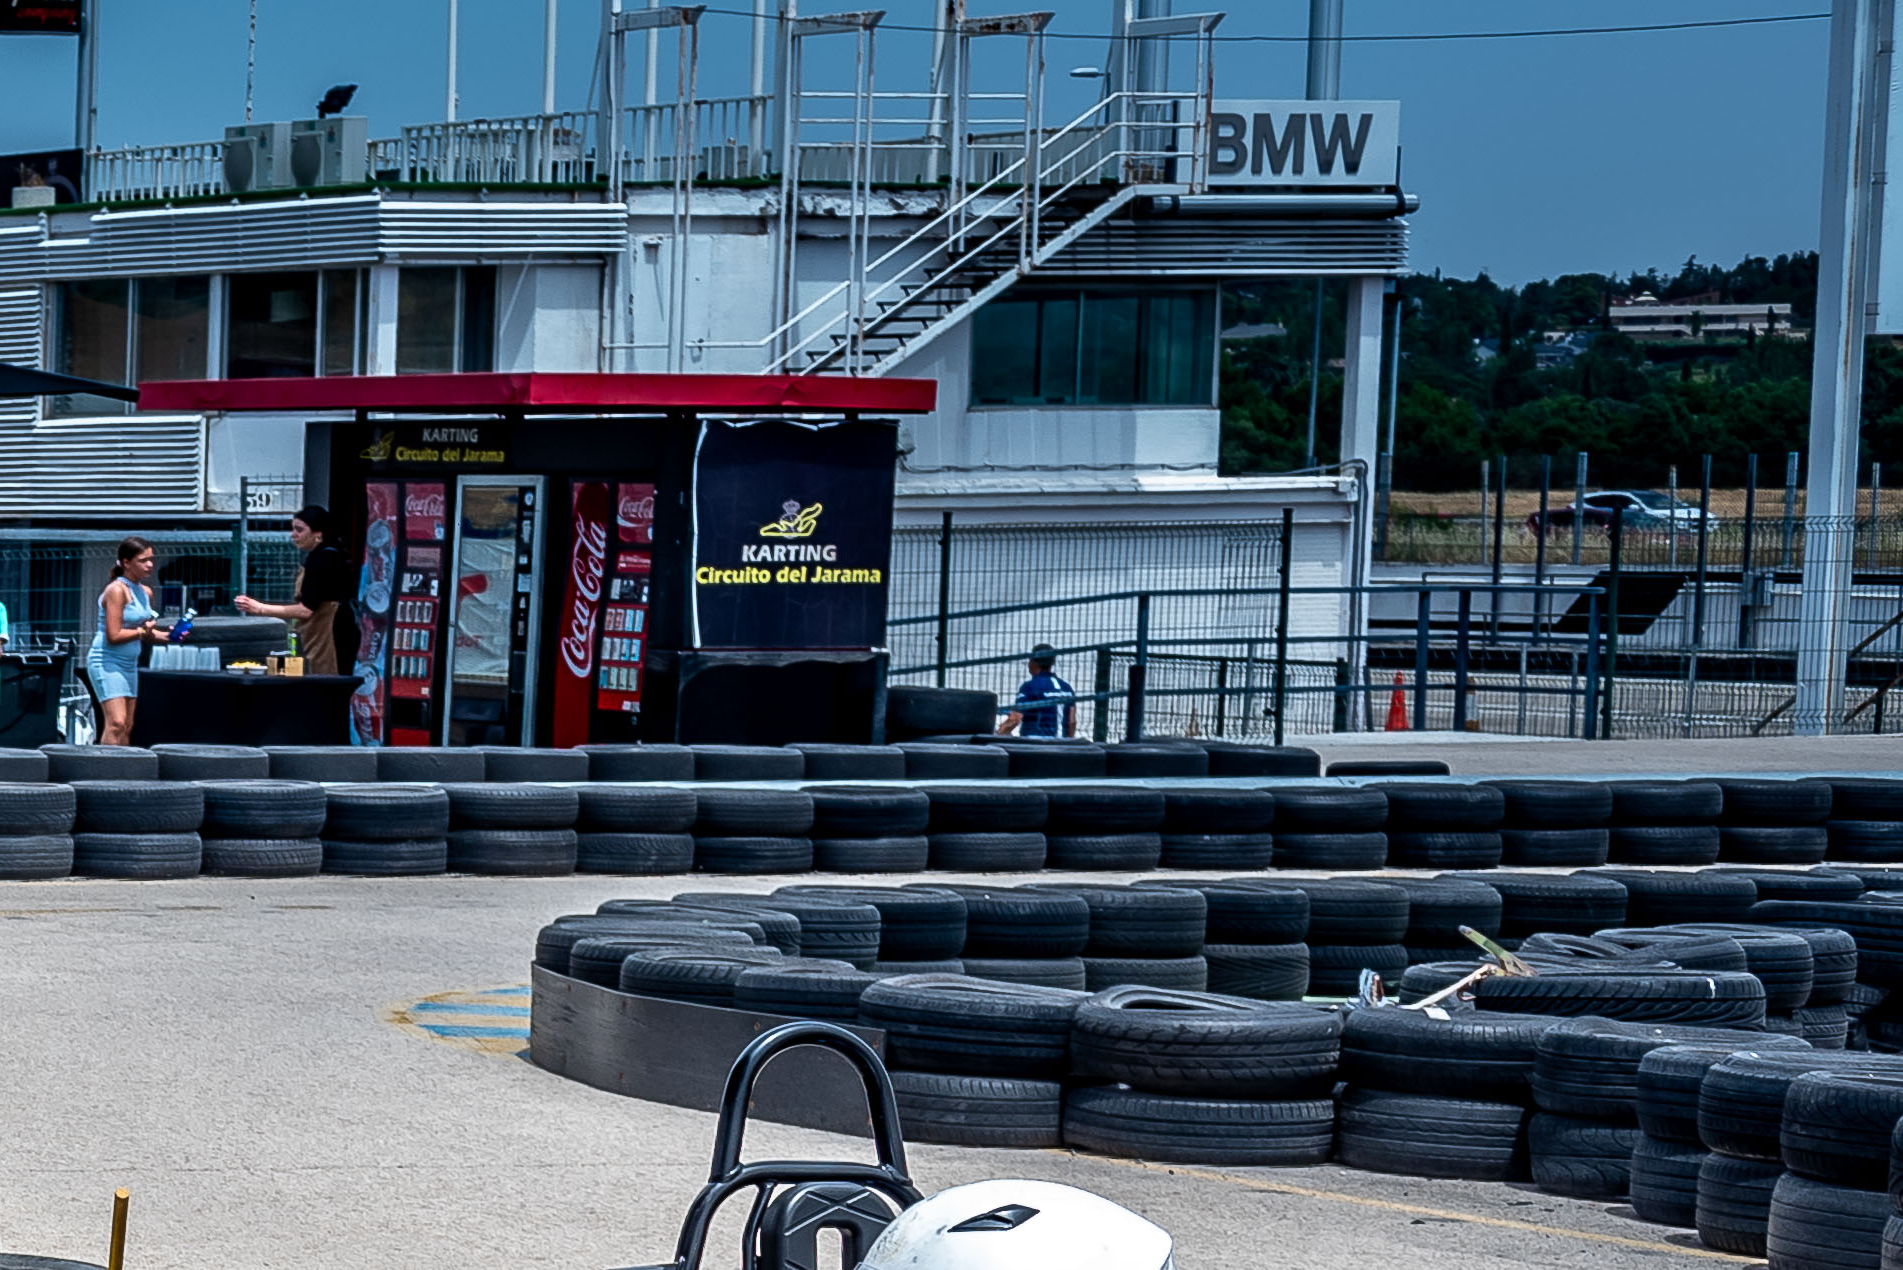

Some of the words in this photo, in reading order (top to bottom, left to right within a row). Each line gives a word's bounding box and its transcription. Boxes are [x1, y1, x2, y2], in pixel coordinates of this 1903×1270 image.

[1208, 113, 1373, 176] BMW
[422, 428, 479, 443] KARTING
[396, 446, 439, 462] Circuito
[443, 446, 460, 461] del
[463, 447, 505, 463] Jarama
[741, 544, 837, 562] KARTING
[696, 566, 771, 584] Circuito
[776, 566, 807, 584] del
[811, 565, 881, 584] Jarama
[561, 513, 607, 678] Coca-Cola
